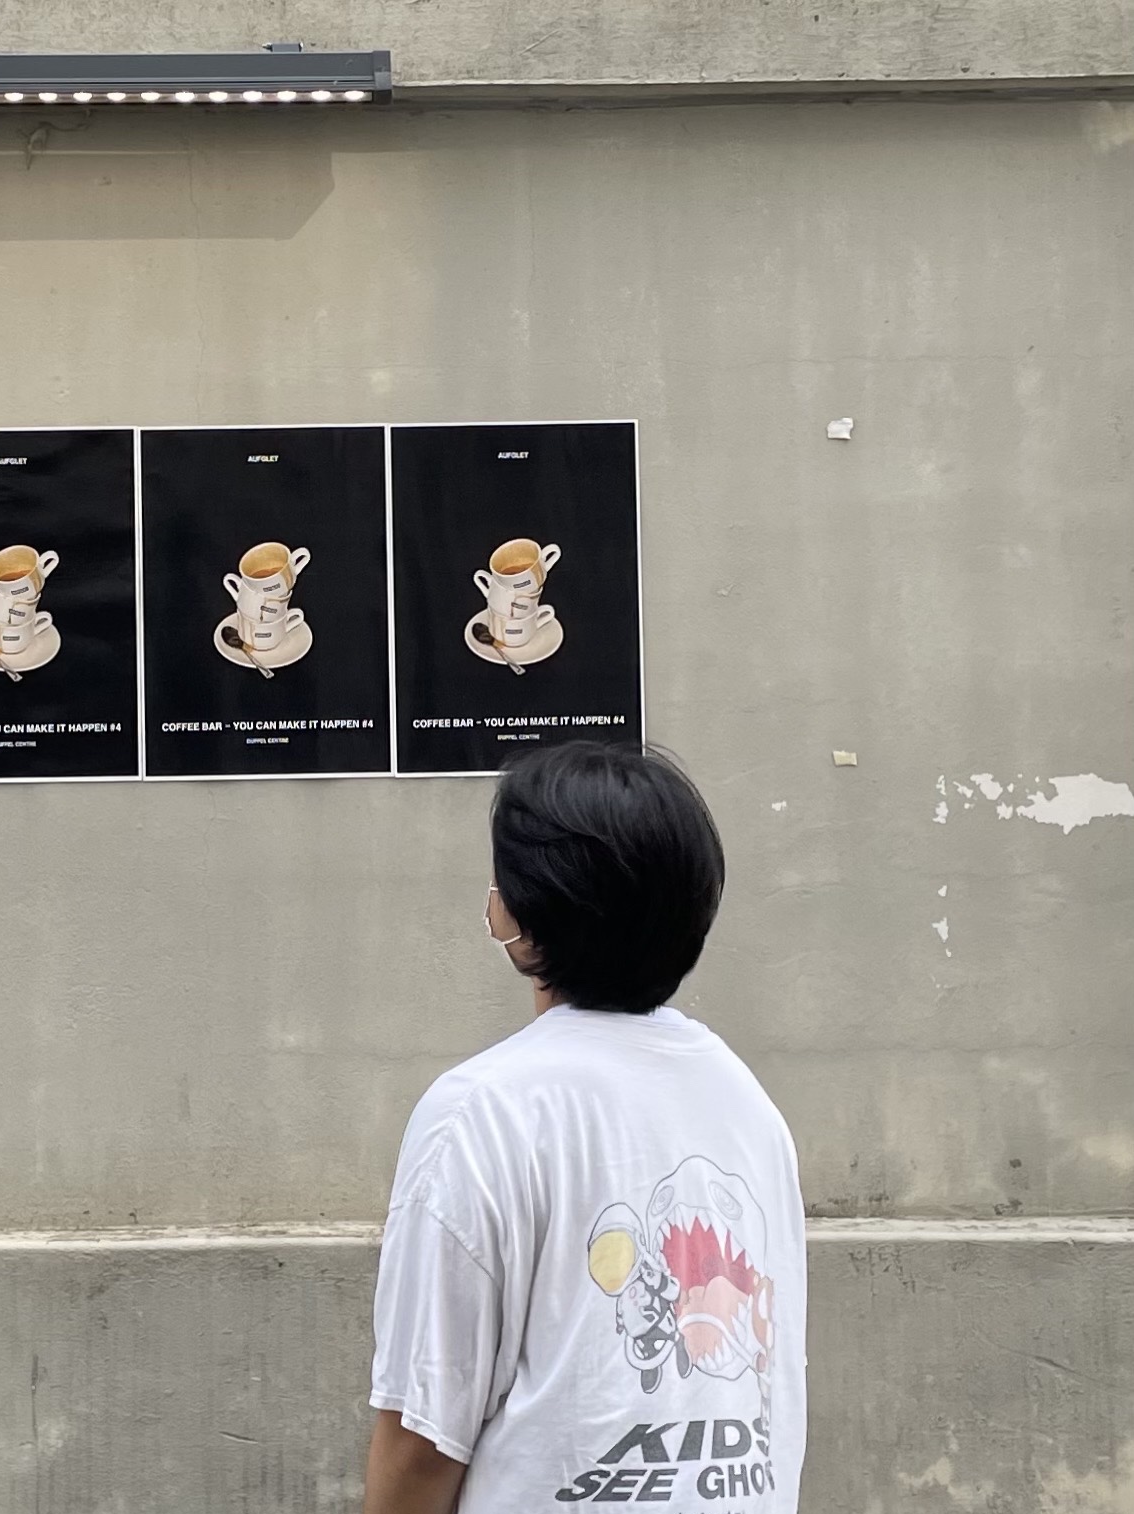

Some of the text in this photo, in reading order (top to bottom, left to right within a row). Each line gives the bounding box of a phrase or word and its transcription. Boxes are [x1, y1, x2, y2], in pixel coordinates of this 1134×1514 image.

[3, 724, 24, 733] CAN
[26, 724, 54, 733] MAKE
[57, 724, 66, 732] IT
[68, 723, 107, 732] HAPPEN
[110, 723, 121, 732] #4
[162, 722, 200, 732] COFFEE
[202, 722, 222, 731] BAR
[233, 721, 253, 730] YOU
[256, 721, 276, 730] CAN
[279, 720, 306, 729] MAKE
[309, 720, 318, 729] IT
[321, 720, 359, 729] HAPPEN
[362, 719, 373, 728] #4
[413, 719, 451, 728] COFFEE
[453, 718, 473, 727] BAR
[484, 718, 504, 727] YOU
[507, 717, 528, 726] CAN
[530, 716, 558, 726] MAKE
[560, 716, 570, 725] IT
[572, 716, 611, 725] HAPPEN
[613, 716, 625, 724] #4
[555, 1468, 679, 1502] SEE
